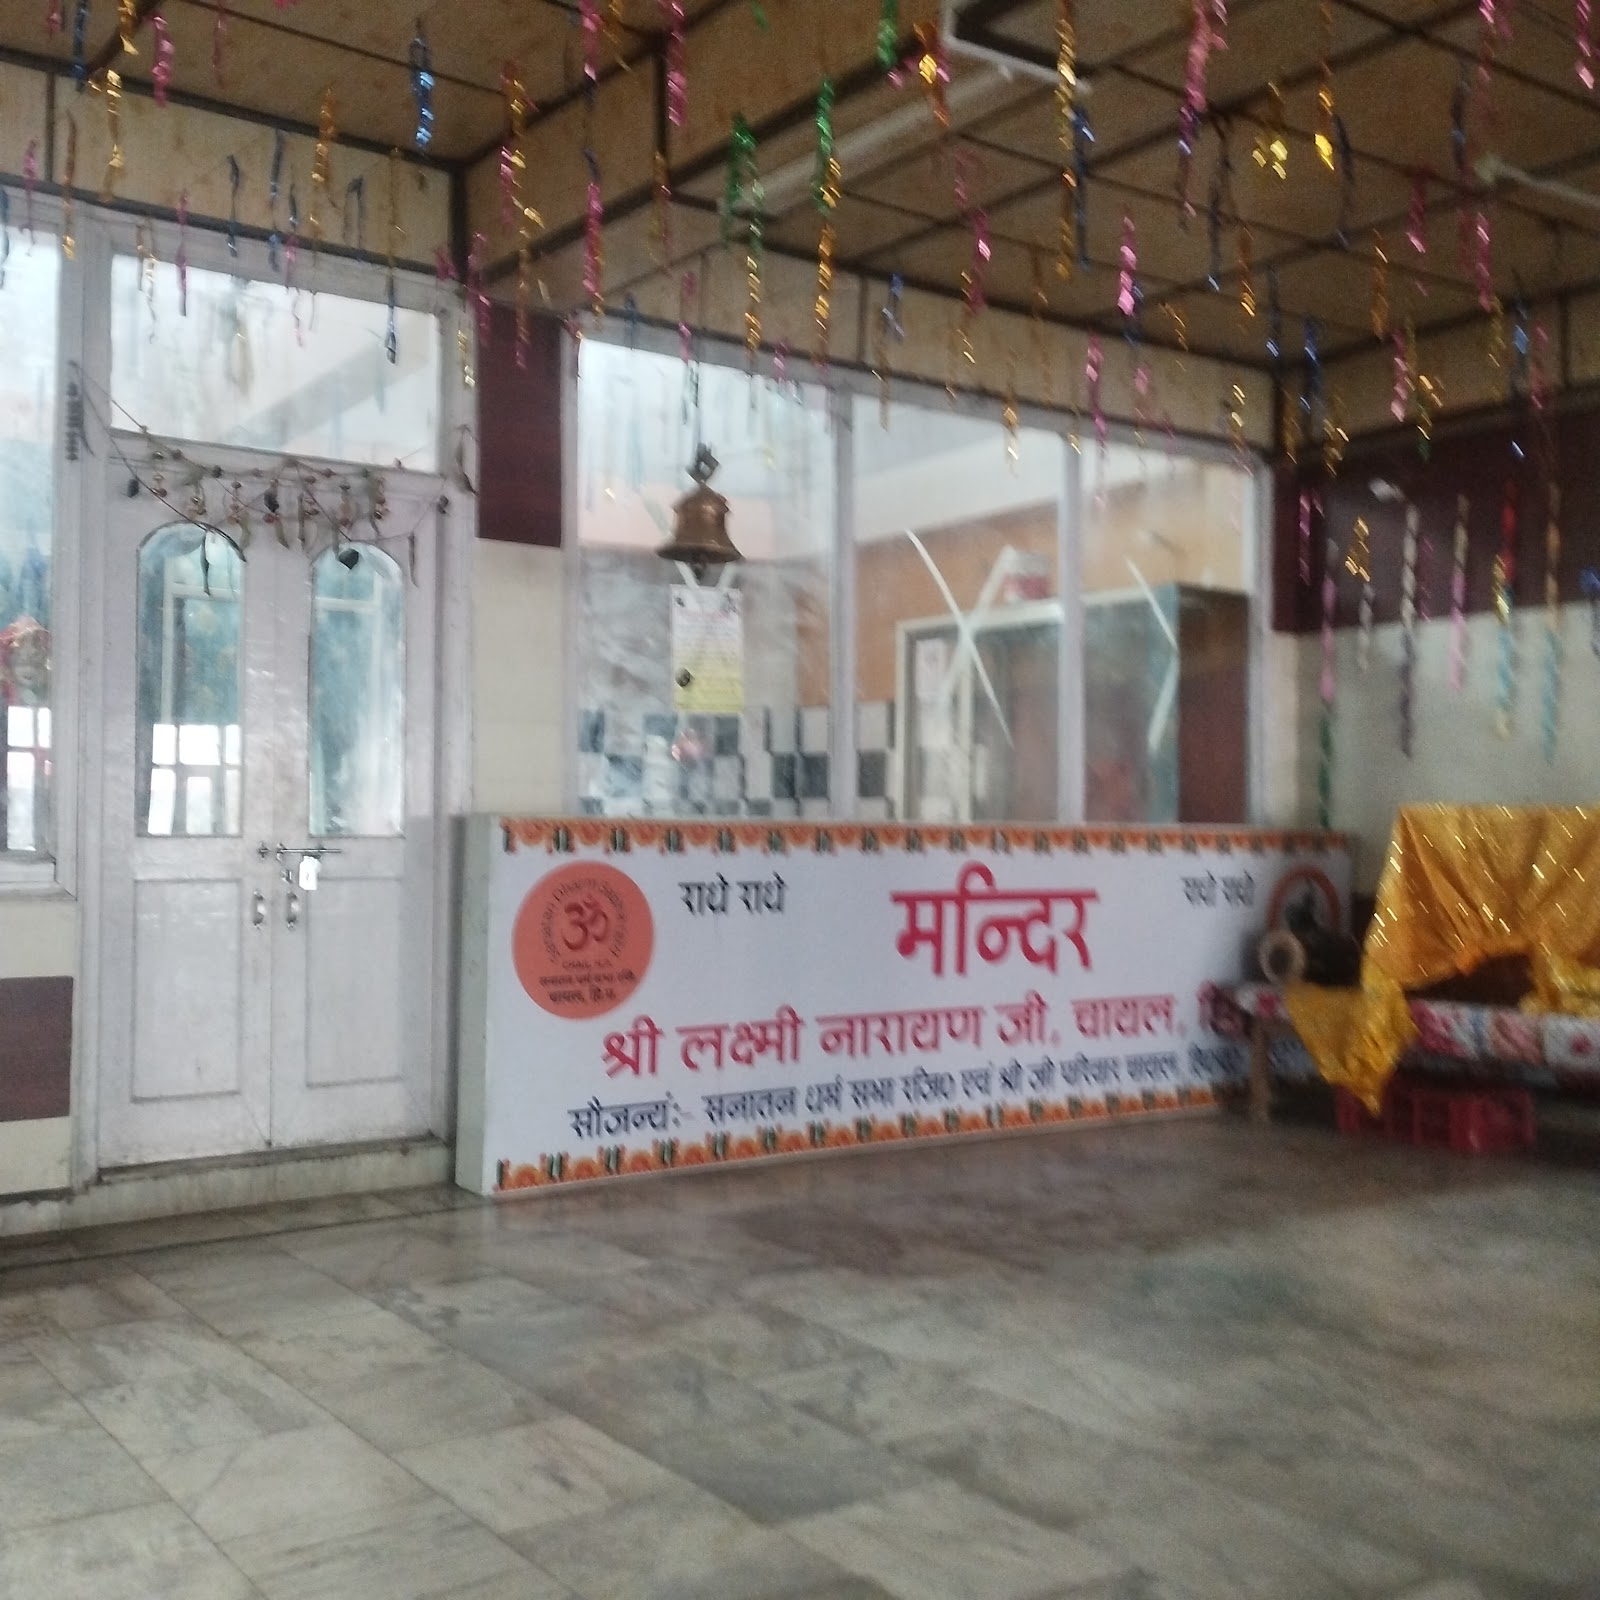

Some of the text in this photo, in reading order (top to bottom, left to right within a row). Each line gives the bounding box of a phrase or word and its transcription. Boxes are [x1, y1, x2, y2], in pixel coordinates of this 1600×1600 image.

[679, 871, 788, 916] राधे राधे
[890, 860, 1099, 976] मन्दिर
[601, 1014, 664, 1078] श्री
[675, 1004, 804, 1070] लक्ष्मी
[815, 1006, 986, 1058] नारायण
[701, 1085, 798, 1125] सनातन
[805, 1073, 844, 1114] धर्म
[848, 1076, 897, 1110] सभा
